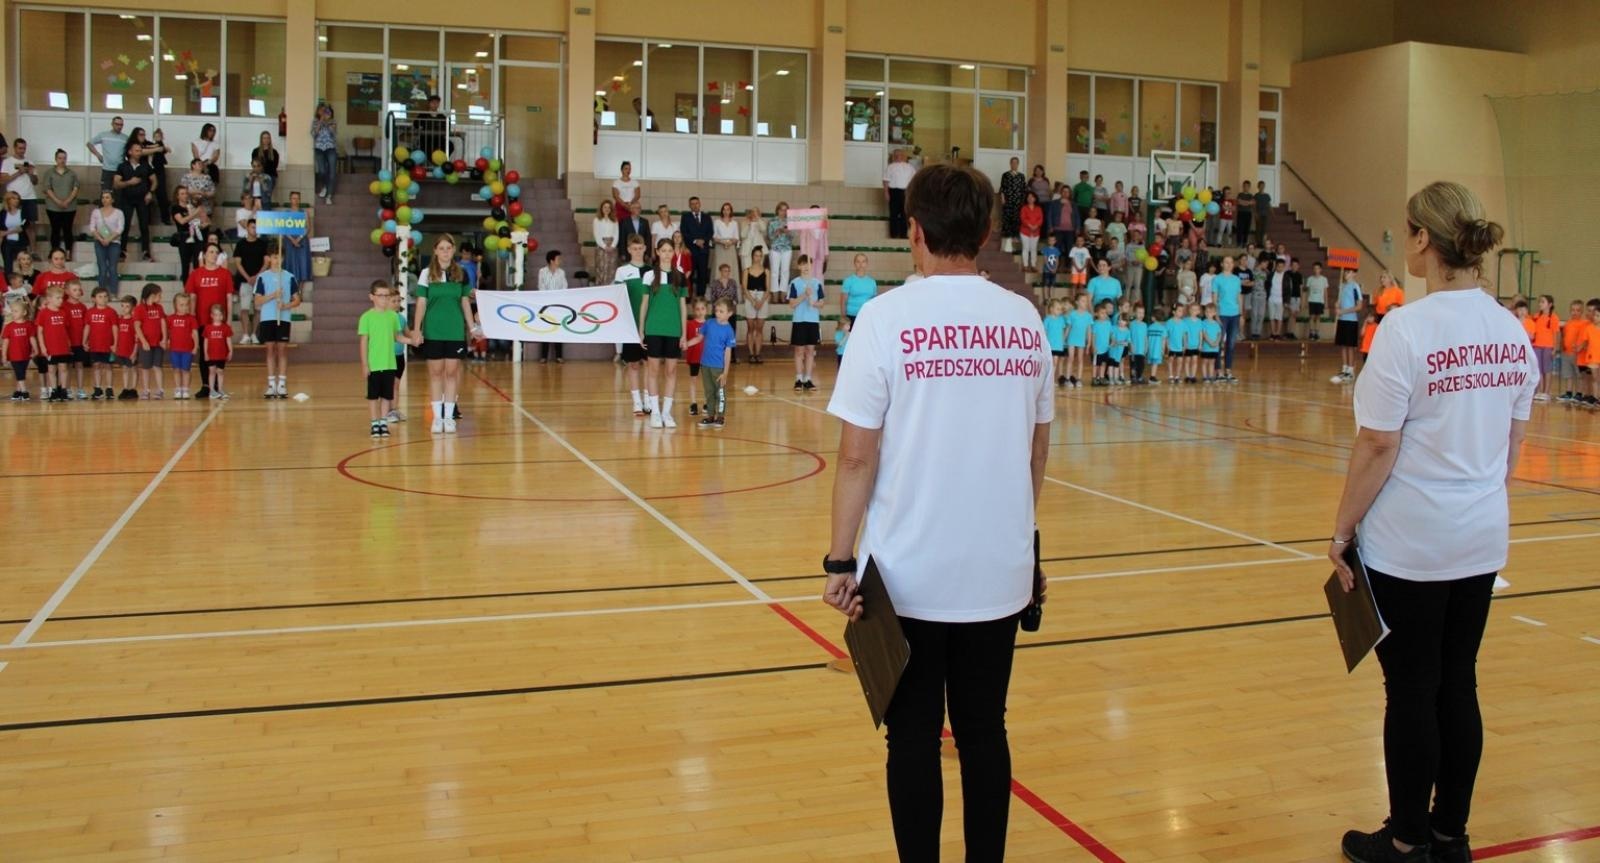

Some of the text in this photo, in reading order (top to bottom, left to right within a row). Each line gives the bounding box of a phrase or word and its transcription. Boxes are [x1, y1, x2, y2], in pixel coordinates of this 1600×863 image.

[900, 325, 1042, 354] SPARTAKIADA
[904, 355, 1043, 381] PRZEDSZKOLAKÓW
[1427, 343, 1527, 375] SPARTAKIADA
[1428, 371, 1527, 397] PRZESZKOLAKW
